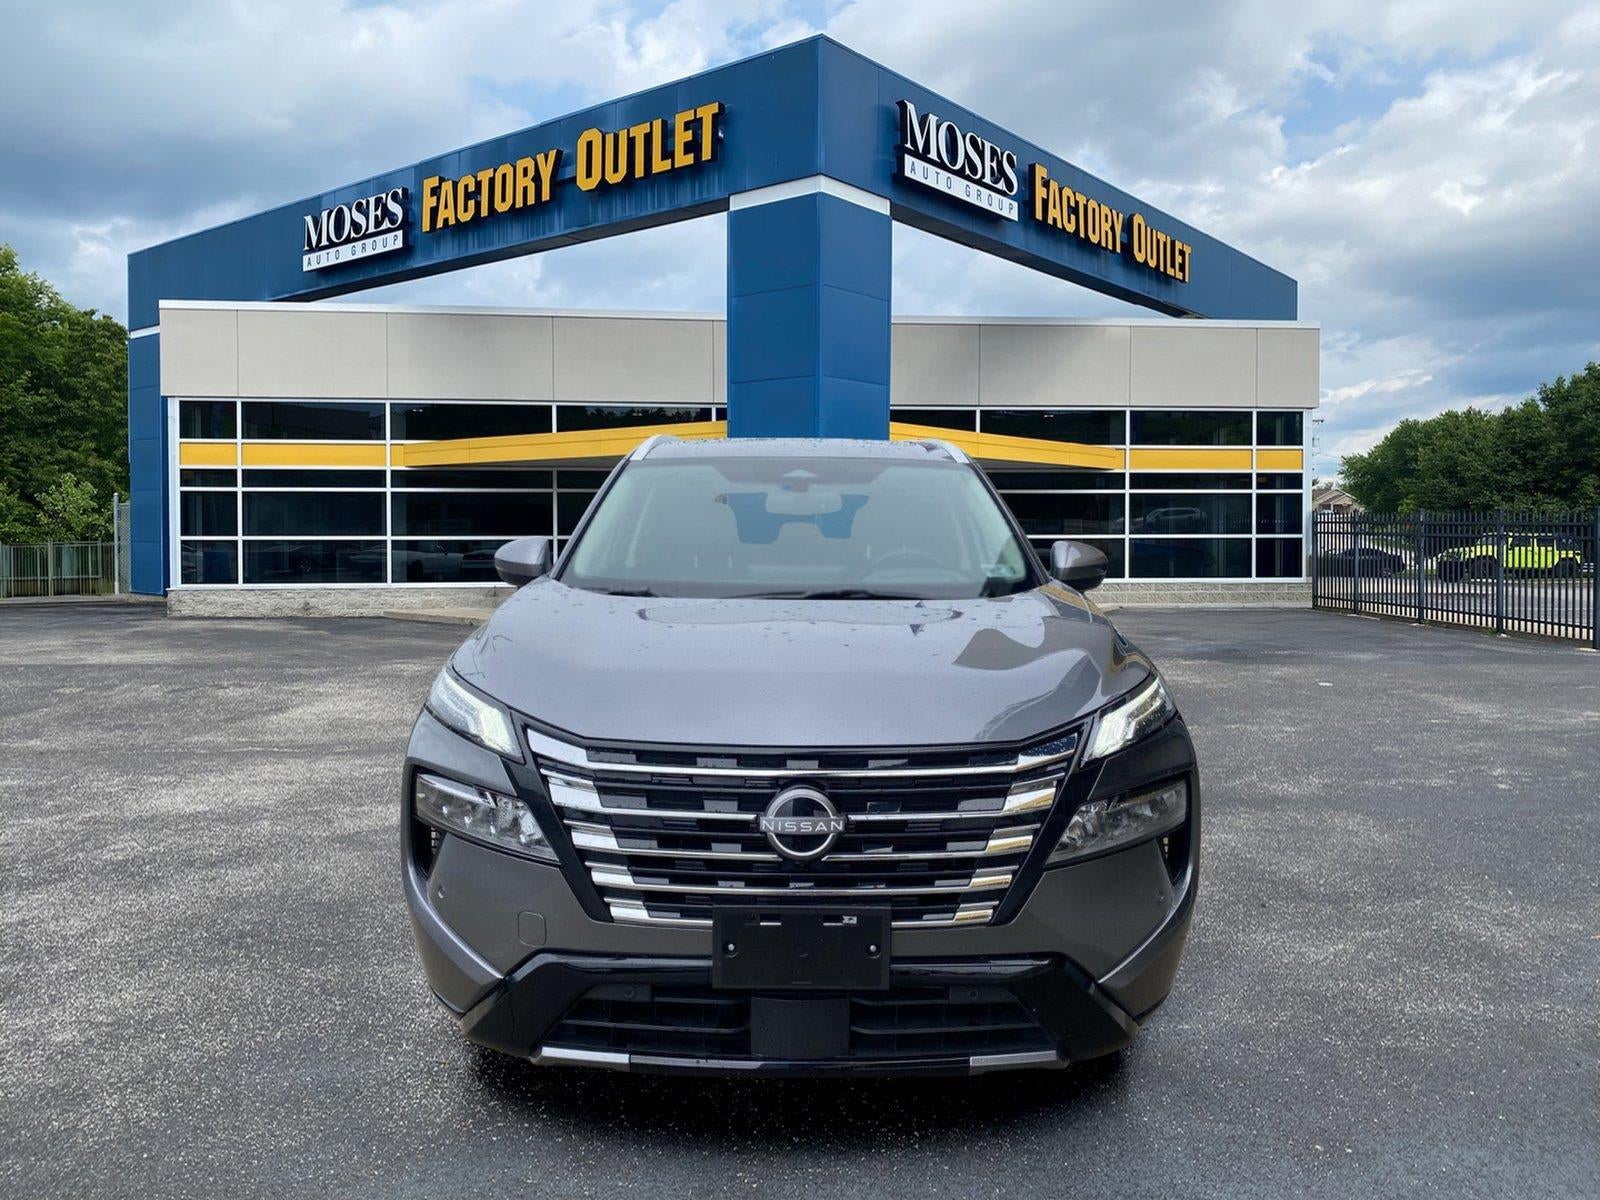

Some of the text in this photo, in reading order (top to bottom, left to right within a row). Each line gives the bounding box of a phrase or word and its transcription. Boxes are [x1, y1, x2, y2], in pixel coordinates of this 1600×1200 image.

[422, 101, 721, 233] FACTORY OUTLET
[904, 99, 1018, 196] MOSES
[303, 187, 404, 250] MOSES
[910, 161, 1014, 214] AUTO GROUP
[307, 234, 399, 268] AUTO GROUP
[1034, 162, 1192, 283] FACTORY OUTLET
[762, 820, 843, 832] NISSAN
